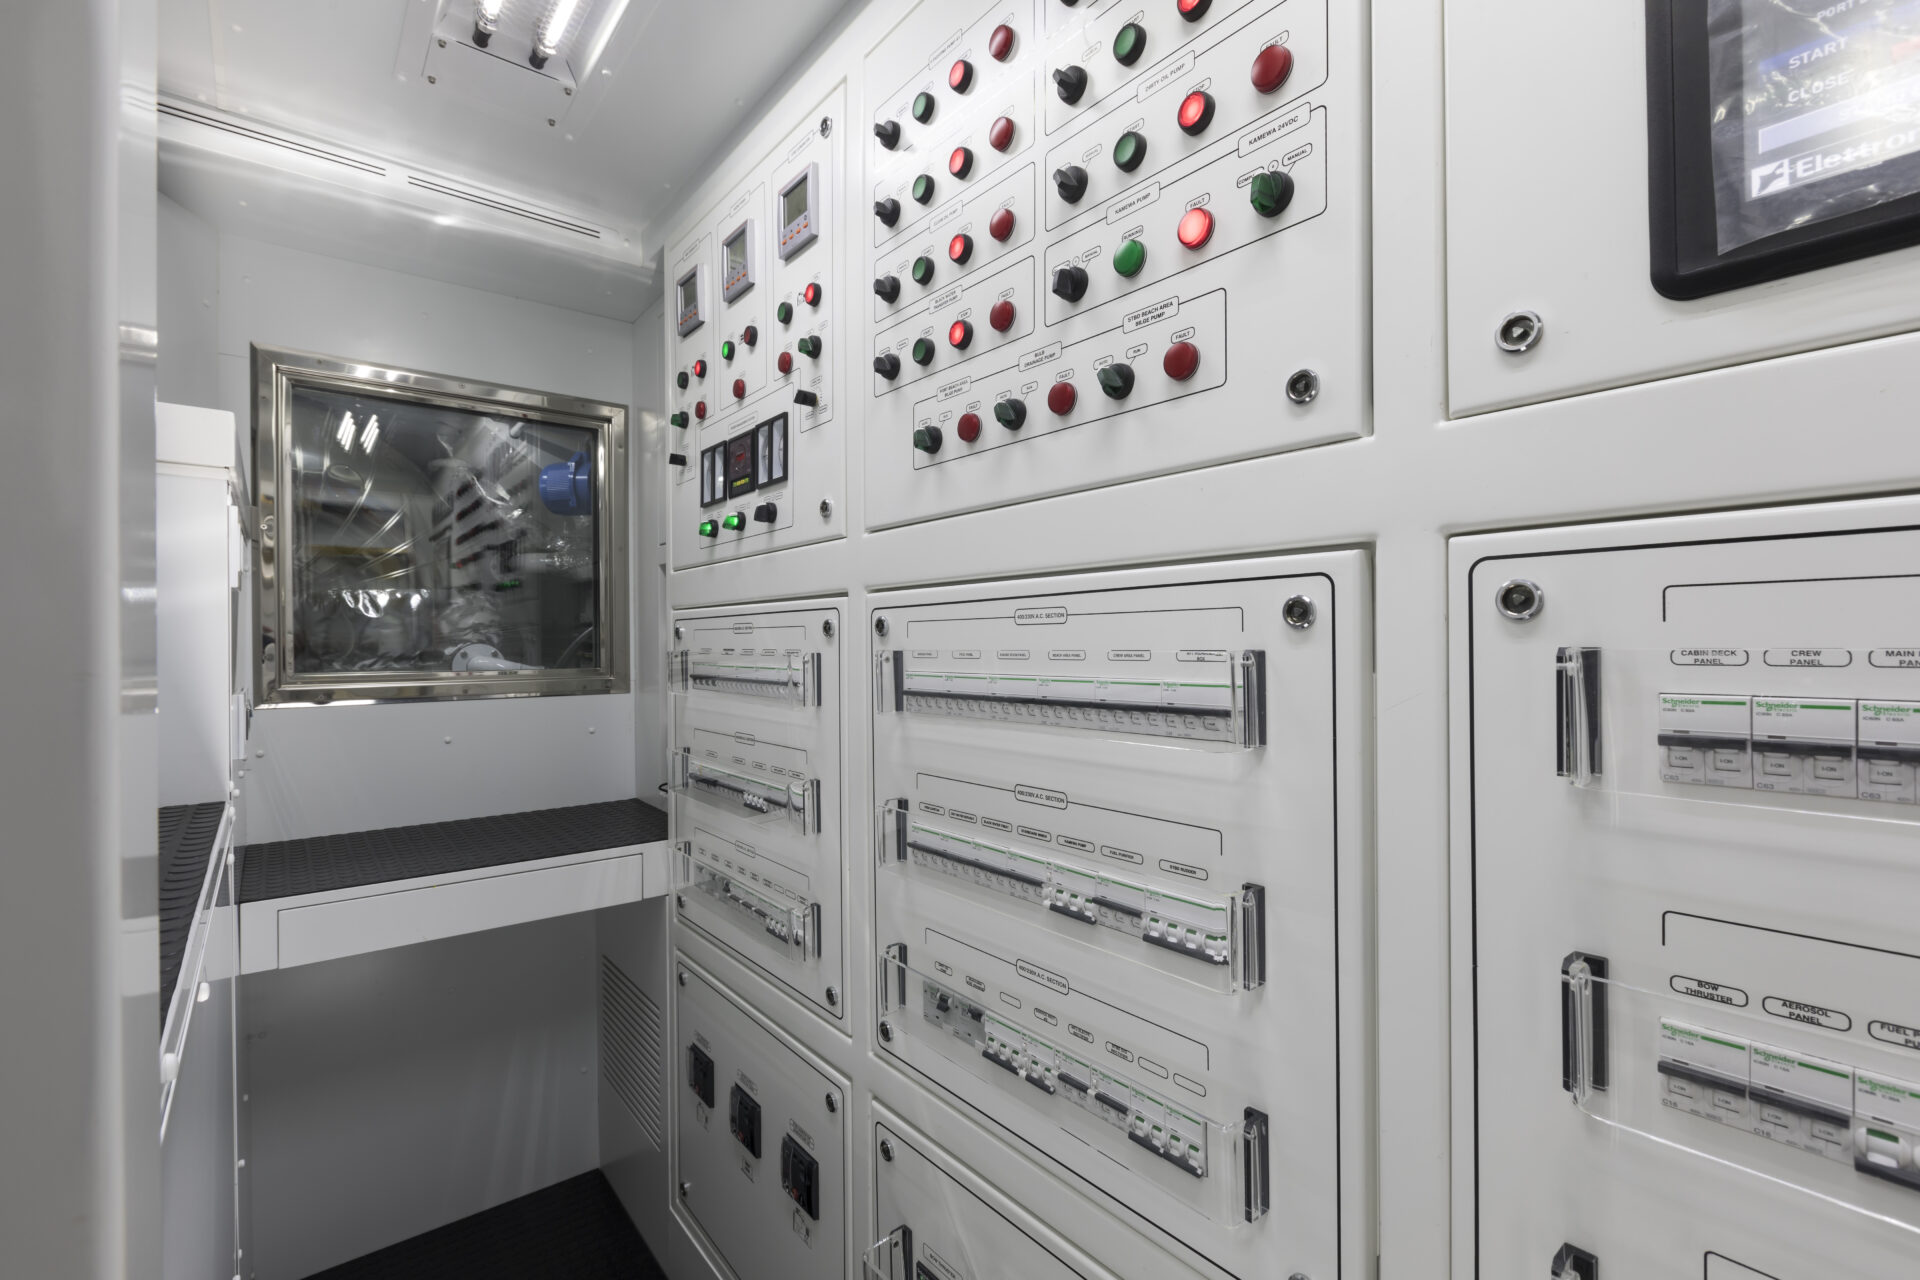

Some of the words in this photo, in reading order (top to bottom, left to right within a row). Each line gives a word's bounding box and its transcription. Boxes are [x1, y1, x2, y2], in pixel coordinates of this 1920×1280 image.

[1788, 36, 1848, 70] START
[1170, 63, 1186, 77] PUMP
[1788, 70, 1850, 102] CLOSE
[1249, 127, 1277, 146] KAMEWA
[1278, 115, 1299, 131] 24VDC
[1287, 149, 1308, 161] MANUAL
[1127, 313, 1141, 322] STBD
[1141, 306, 1159, 317] BEACH
[1159, 300, 1174, 310] AREA
[1135, 318, 1150, 327] BILGE
[1150, 311, 1165, 321] PUMP
[1175, 331, 1190, 340] FAULT
[1680, 649, 1709, 657] CABIN
[1711, 649, 1737, 657] DECK
[1662, 697, 1699, 706] Schneider
[1756, 701, 1798, 711] Schneider
[1862, 704, 1911, 715] Schneider
[1045, 794, 1065, 804] SECTION
[1861, 791, 1881, 800] C63
[1046, 976, 1067, 989] SECTION
[1697, 980, 1719, 992] BOW
[1684, 986, 1734, 1004] THRUSTER
[1781, 1001, 1832, 1018] AEROSOL
[1788, 1011, 1823, 1026] PANEL
[1662, 1024, 1699, 1038] Schneider
[1881, 1023, 1910, 1037] FUEL
[1753, 1048, 1796, 1065] Schneider
[1858, 1076, 1907, 1096] Schneider
